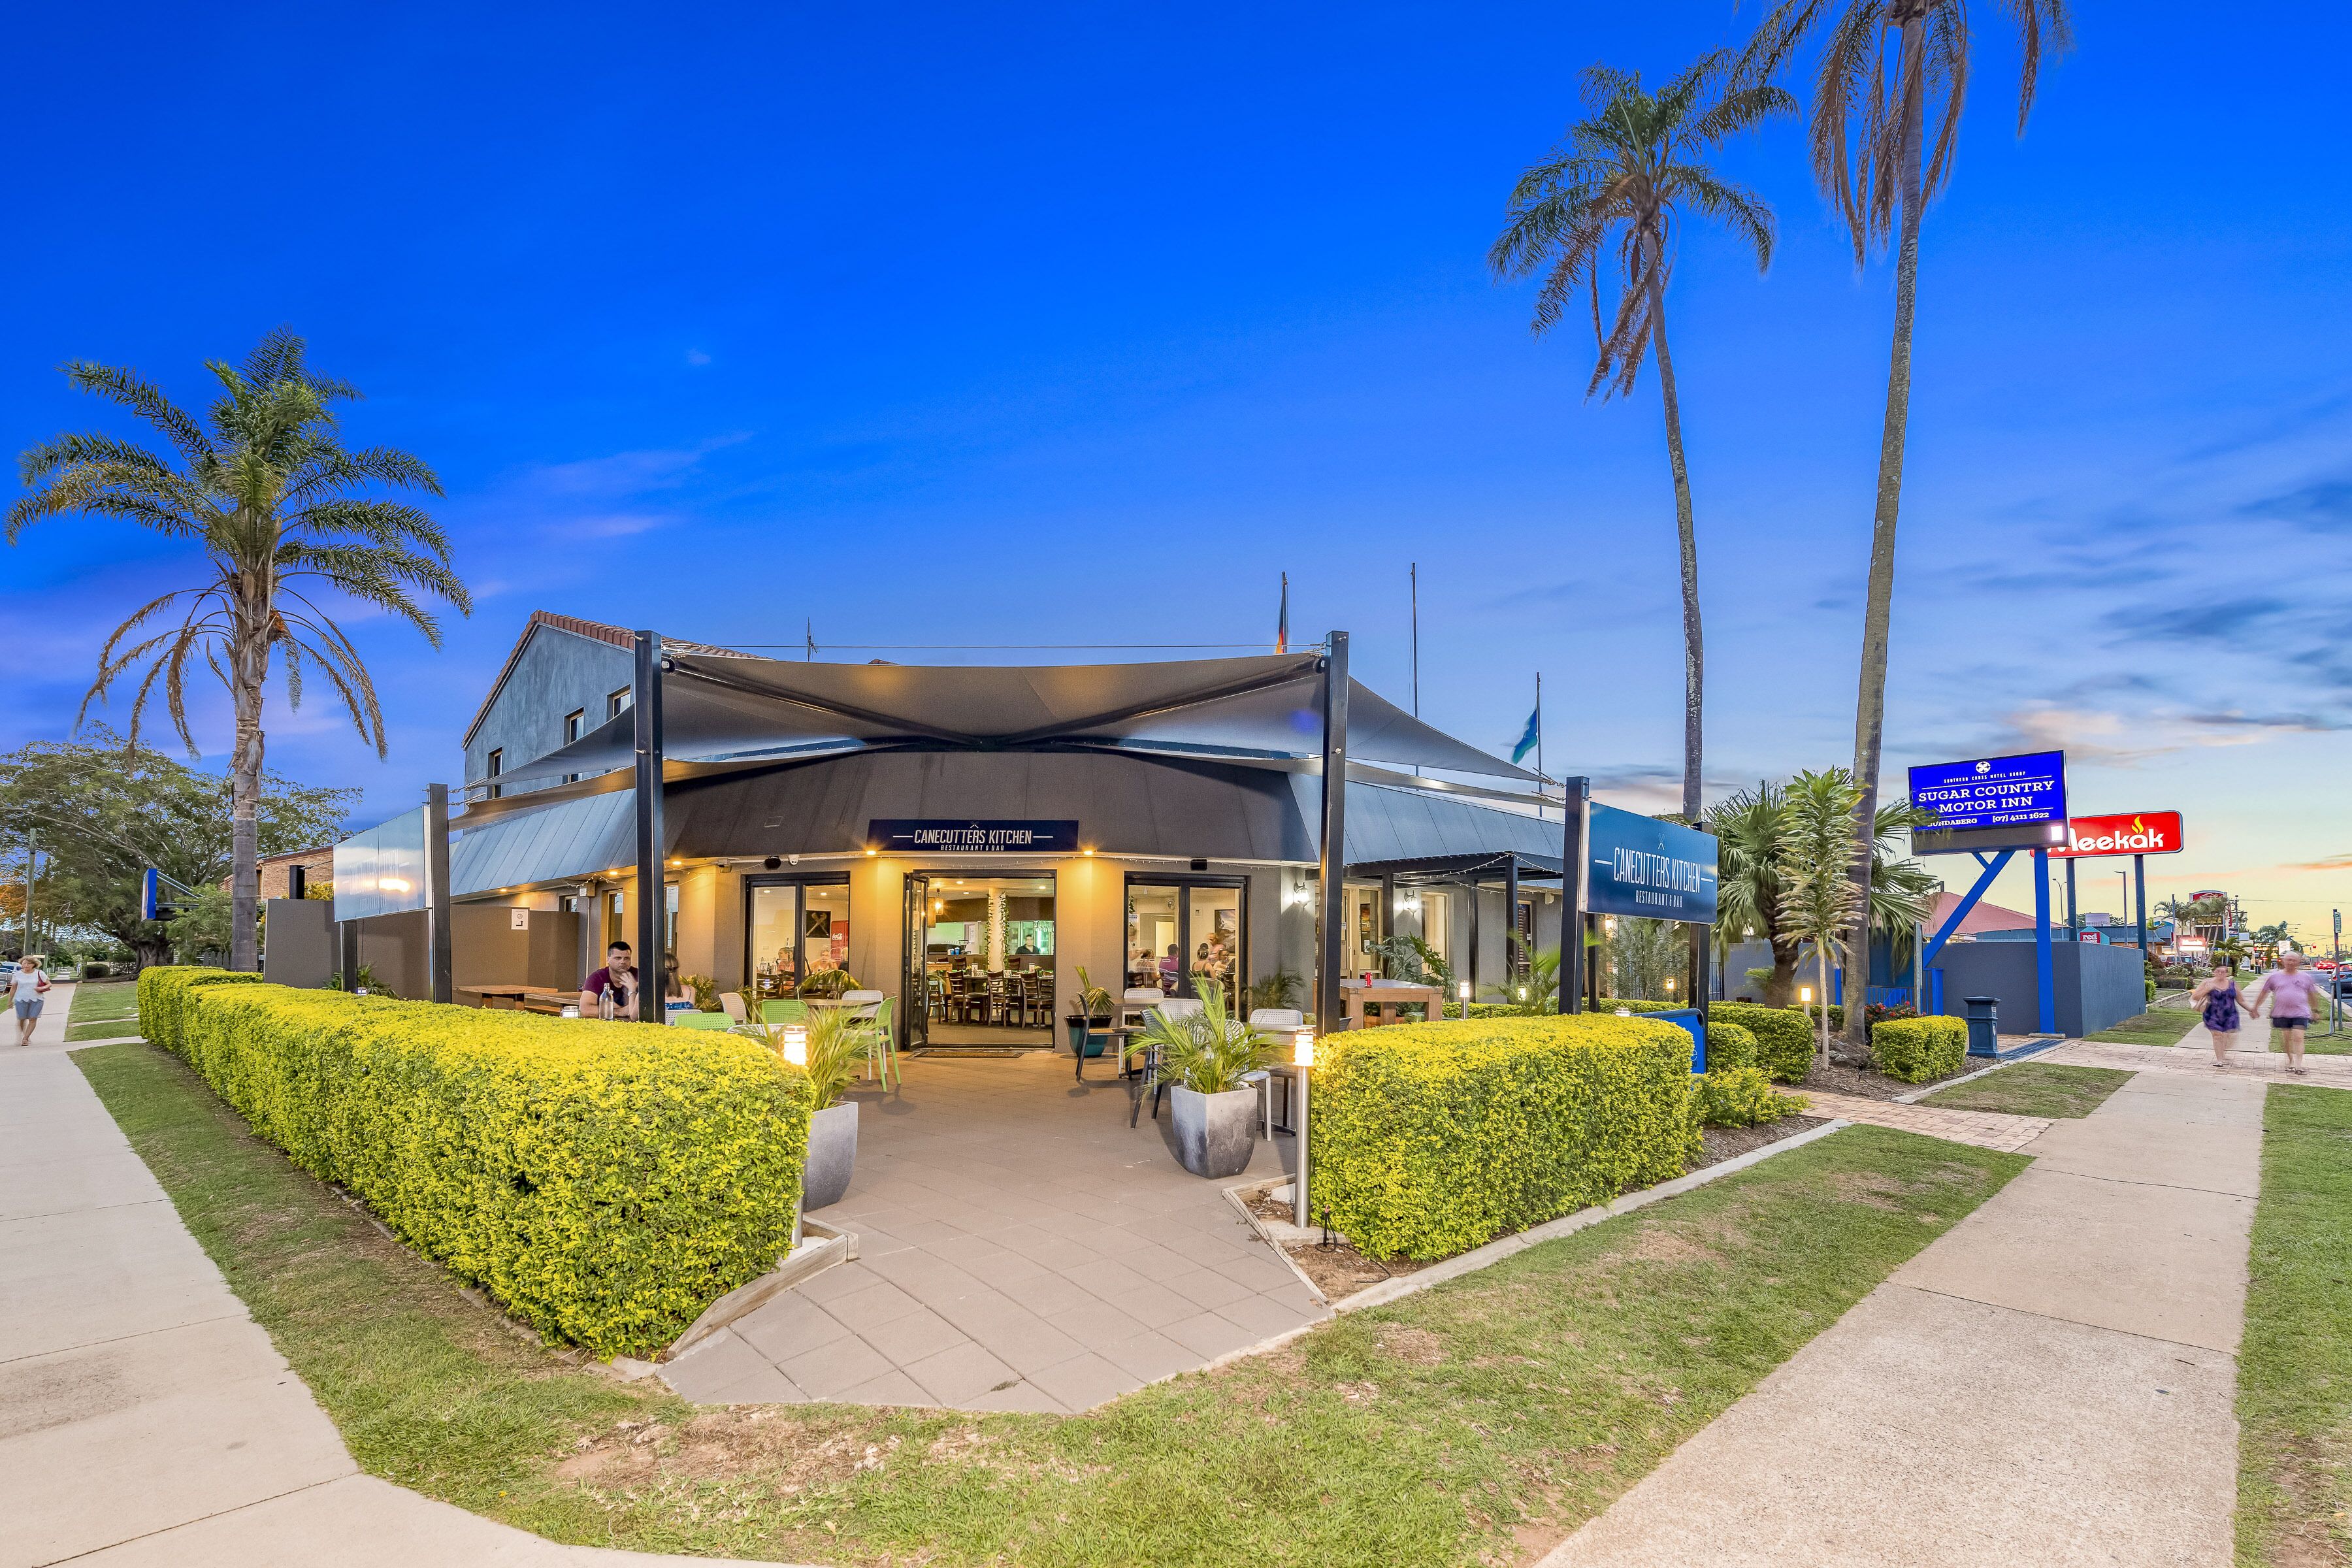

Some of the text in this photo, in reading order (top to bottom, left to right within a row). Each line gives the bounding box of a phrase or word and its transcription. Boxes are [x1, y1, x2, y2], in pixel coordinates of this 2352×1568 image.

[1918, 780, 2055, 802] SUGAR COUNTRY
[1938, 796, 2033, 813] MOTOR INN
[914, 829, 1032, 845] CANECUTTERS KITCHEN
[1613, 846, 1701, 894] CANECUTTERS KITCHEN
[1635, 890, 1669, 906] RESTAURANT
[1673, 895, 1683, 908] BAR
